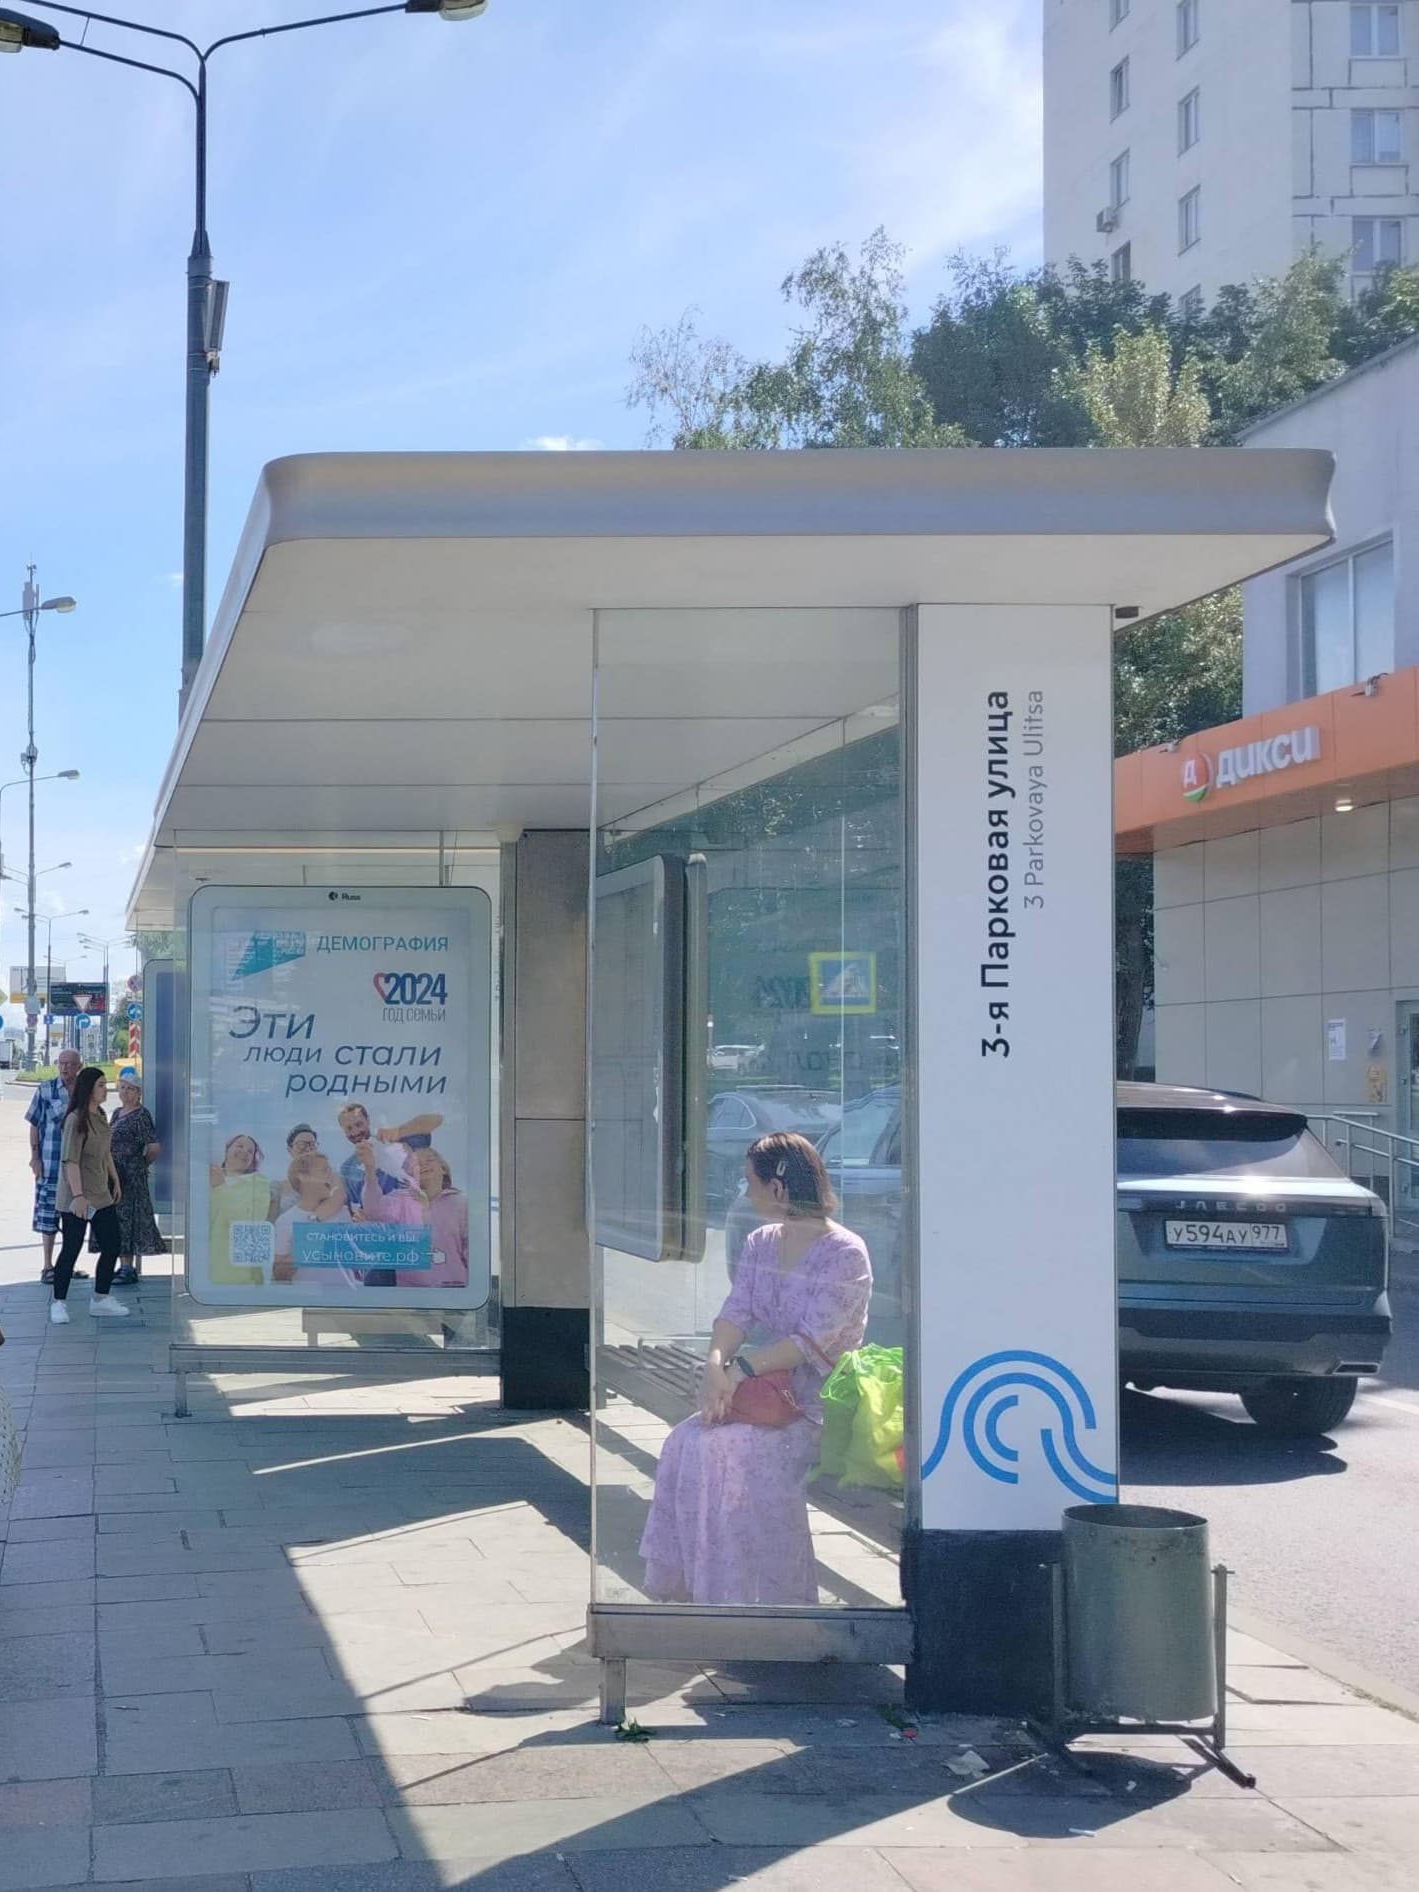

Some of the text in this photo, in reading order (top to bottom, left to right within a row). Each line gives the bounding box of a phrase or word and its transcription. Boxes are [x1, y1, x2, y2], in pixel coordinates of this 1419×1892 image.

[1023, 690, 1048, 909] 3 Parkovaya Ulitsa
[981, 690, 1016, 1058] 3-я Парковая улица
[316, 935, 449, 953] ДЕМОГРАФИЯ
[383, 972, 448, 1005] 2024
[229, 1004, 317, 1040] Эти
[242, 1045, 442, 1067] люди стали
[285, 1073, 447, 1098] родными
